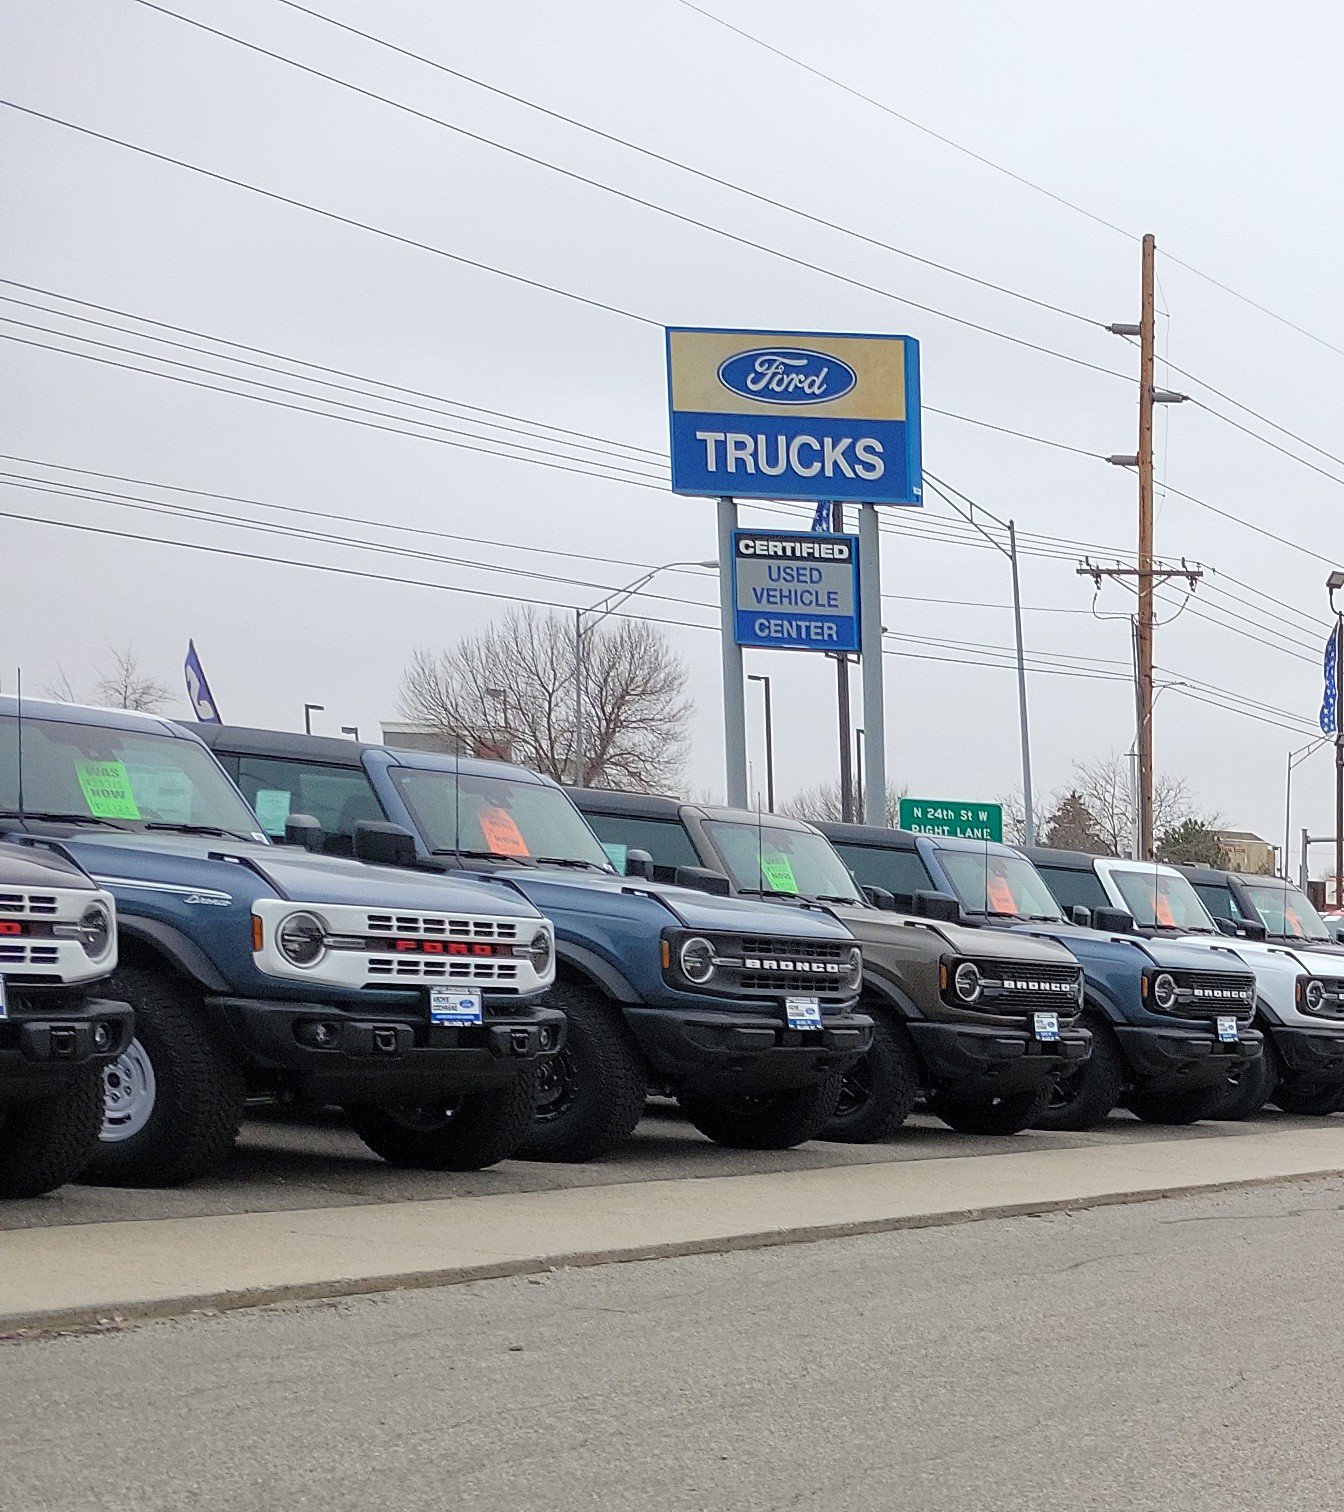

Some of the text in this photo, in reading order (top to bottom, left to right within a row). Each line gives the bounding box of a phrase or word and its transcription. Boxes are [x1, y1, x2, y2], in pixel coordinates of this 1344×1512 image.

[746, 355, 828, 396] Ford
[695, 430, 886, 481] TRUCKS
[738, 539, 850, 560] CERTIFIED
[767, 565, 823, 585] USED
[752, 587, 840, 609] VEHICLE
[754, 618, 838, 641] CENTER
[90, 788, 126, 799] NOW
[913, 806, 988, 822] N 24th St W
[911, 824, 991, 840] RIGHT LANE
[395, 940, 493, 956] FORD
[744, 959, 839, 973] BRONCO
[1003, 980, 1070, 991] BRONCO
